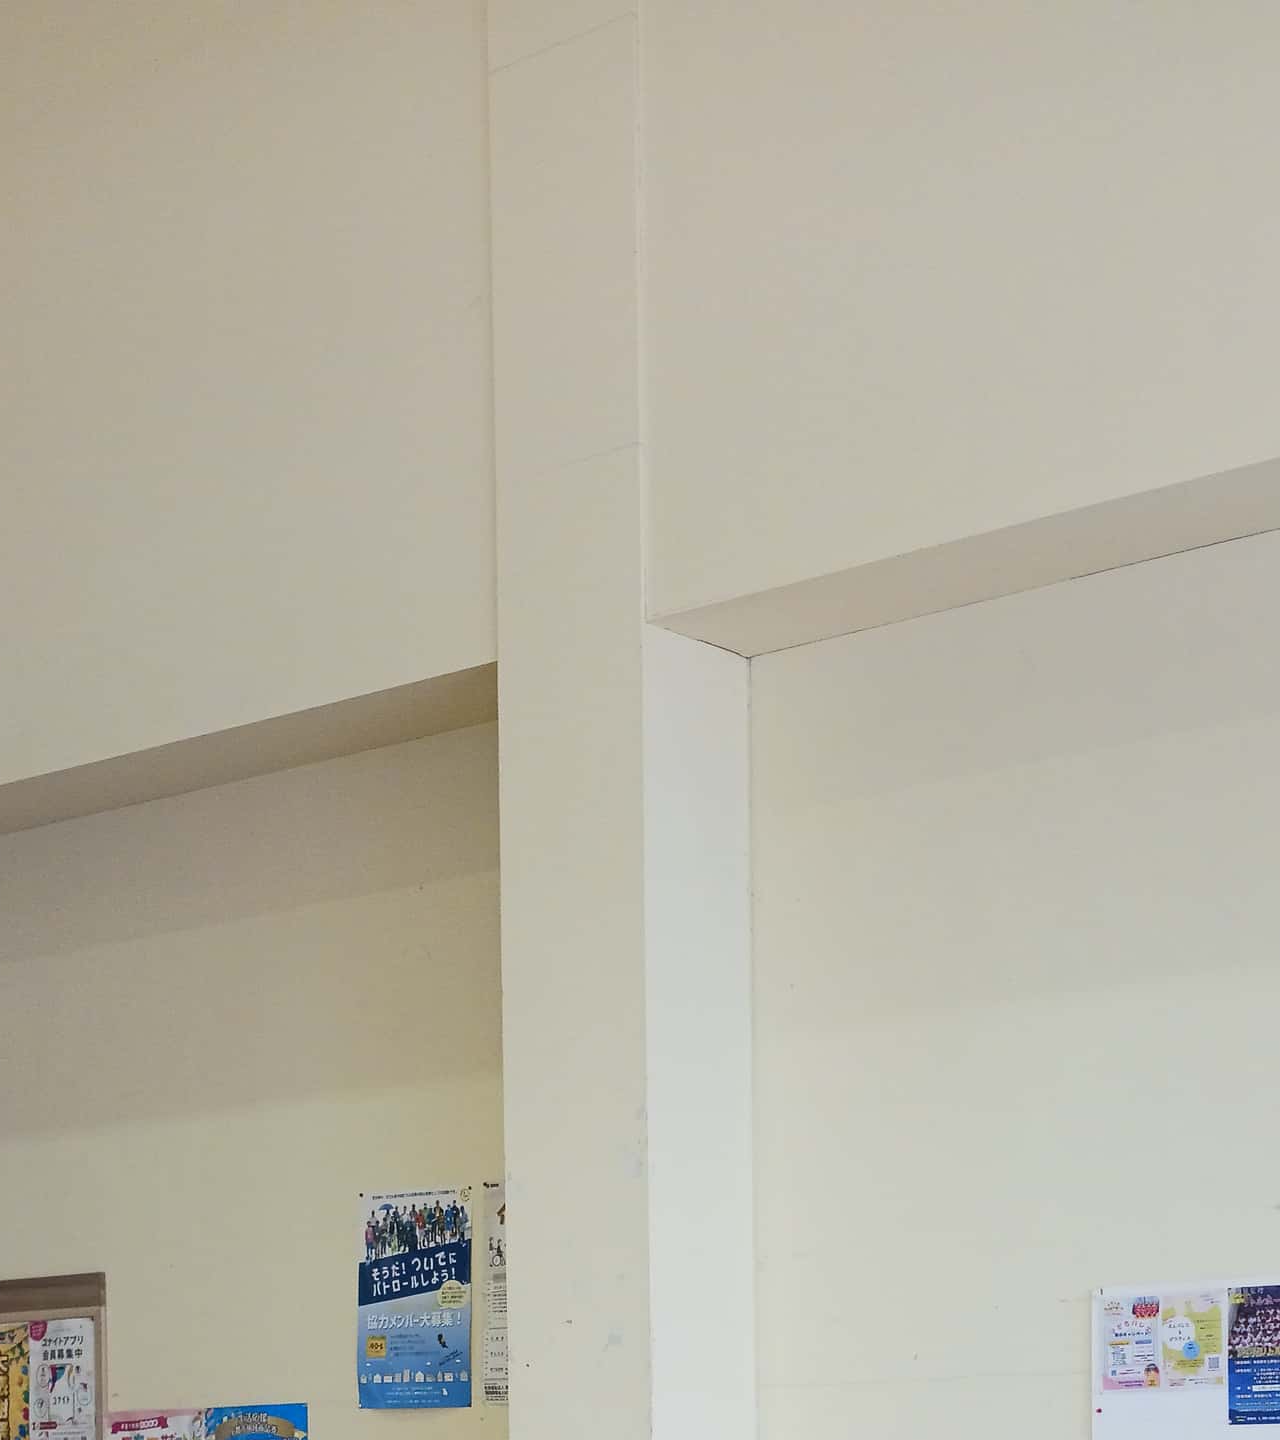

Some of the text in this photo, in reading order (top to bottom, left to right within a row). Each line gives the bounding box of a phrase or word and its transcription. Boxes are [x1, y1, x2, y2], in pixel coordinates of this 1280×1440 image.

[411, 1251, 458, 1271] ついでに
[41, 1334, 84, 1347] ユナイトアプリ
[42, 1347, 83, 1361] 会員募集中
